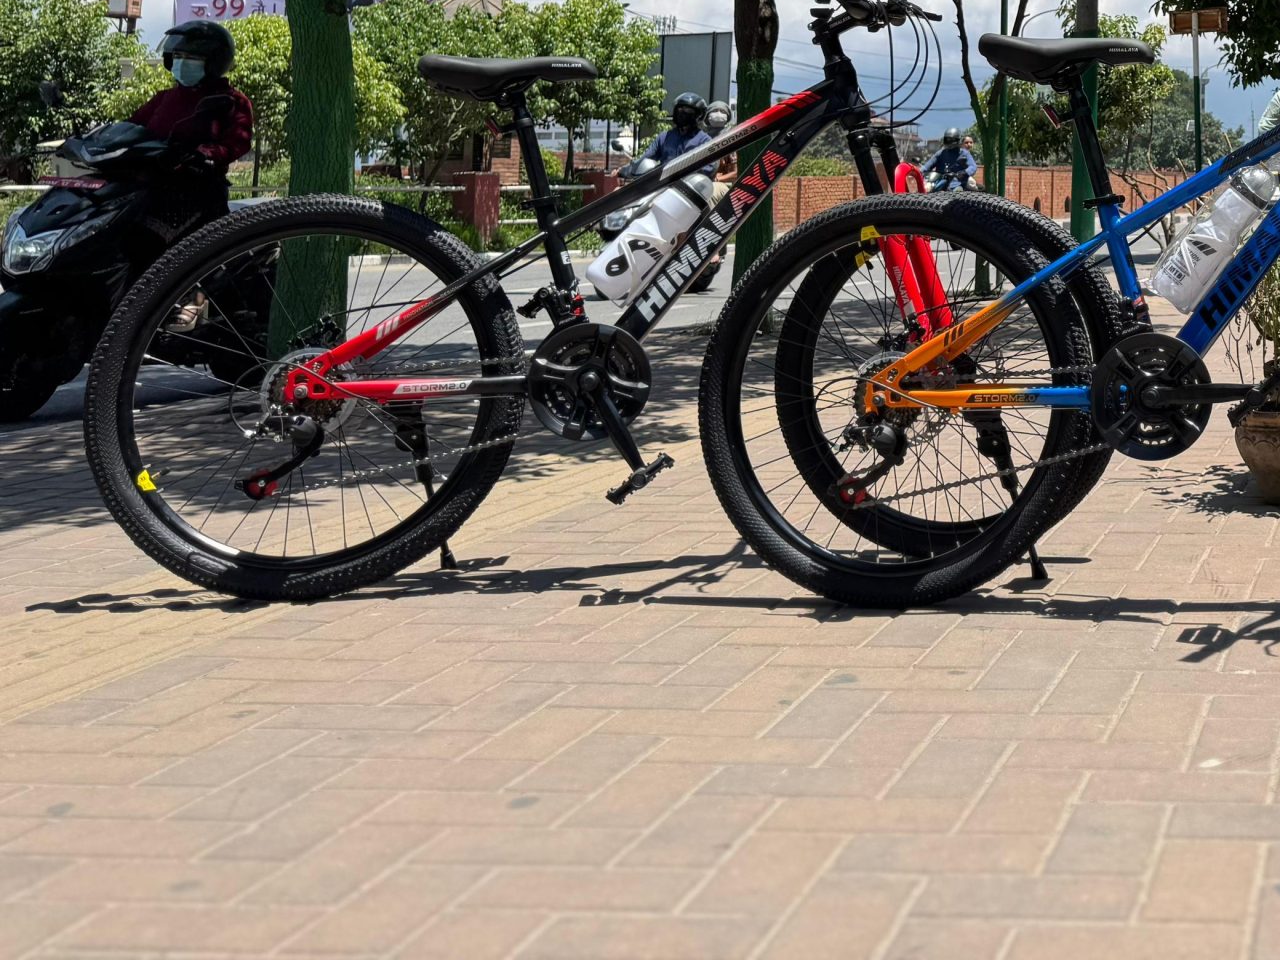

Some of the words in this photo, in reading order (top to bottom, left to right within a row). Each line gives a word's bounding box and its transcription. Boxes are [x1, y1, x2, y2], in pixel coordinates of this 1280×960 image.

[707, 124, 758, 153] STORM2.0
[634, 150, 788, 323] HIMALAYA
[403, 382, 467, 393] STORM2.0
[974, 394, 1037, 403] STORM2.0
